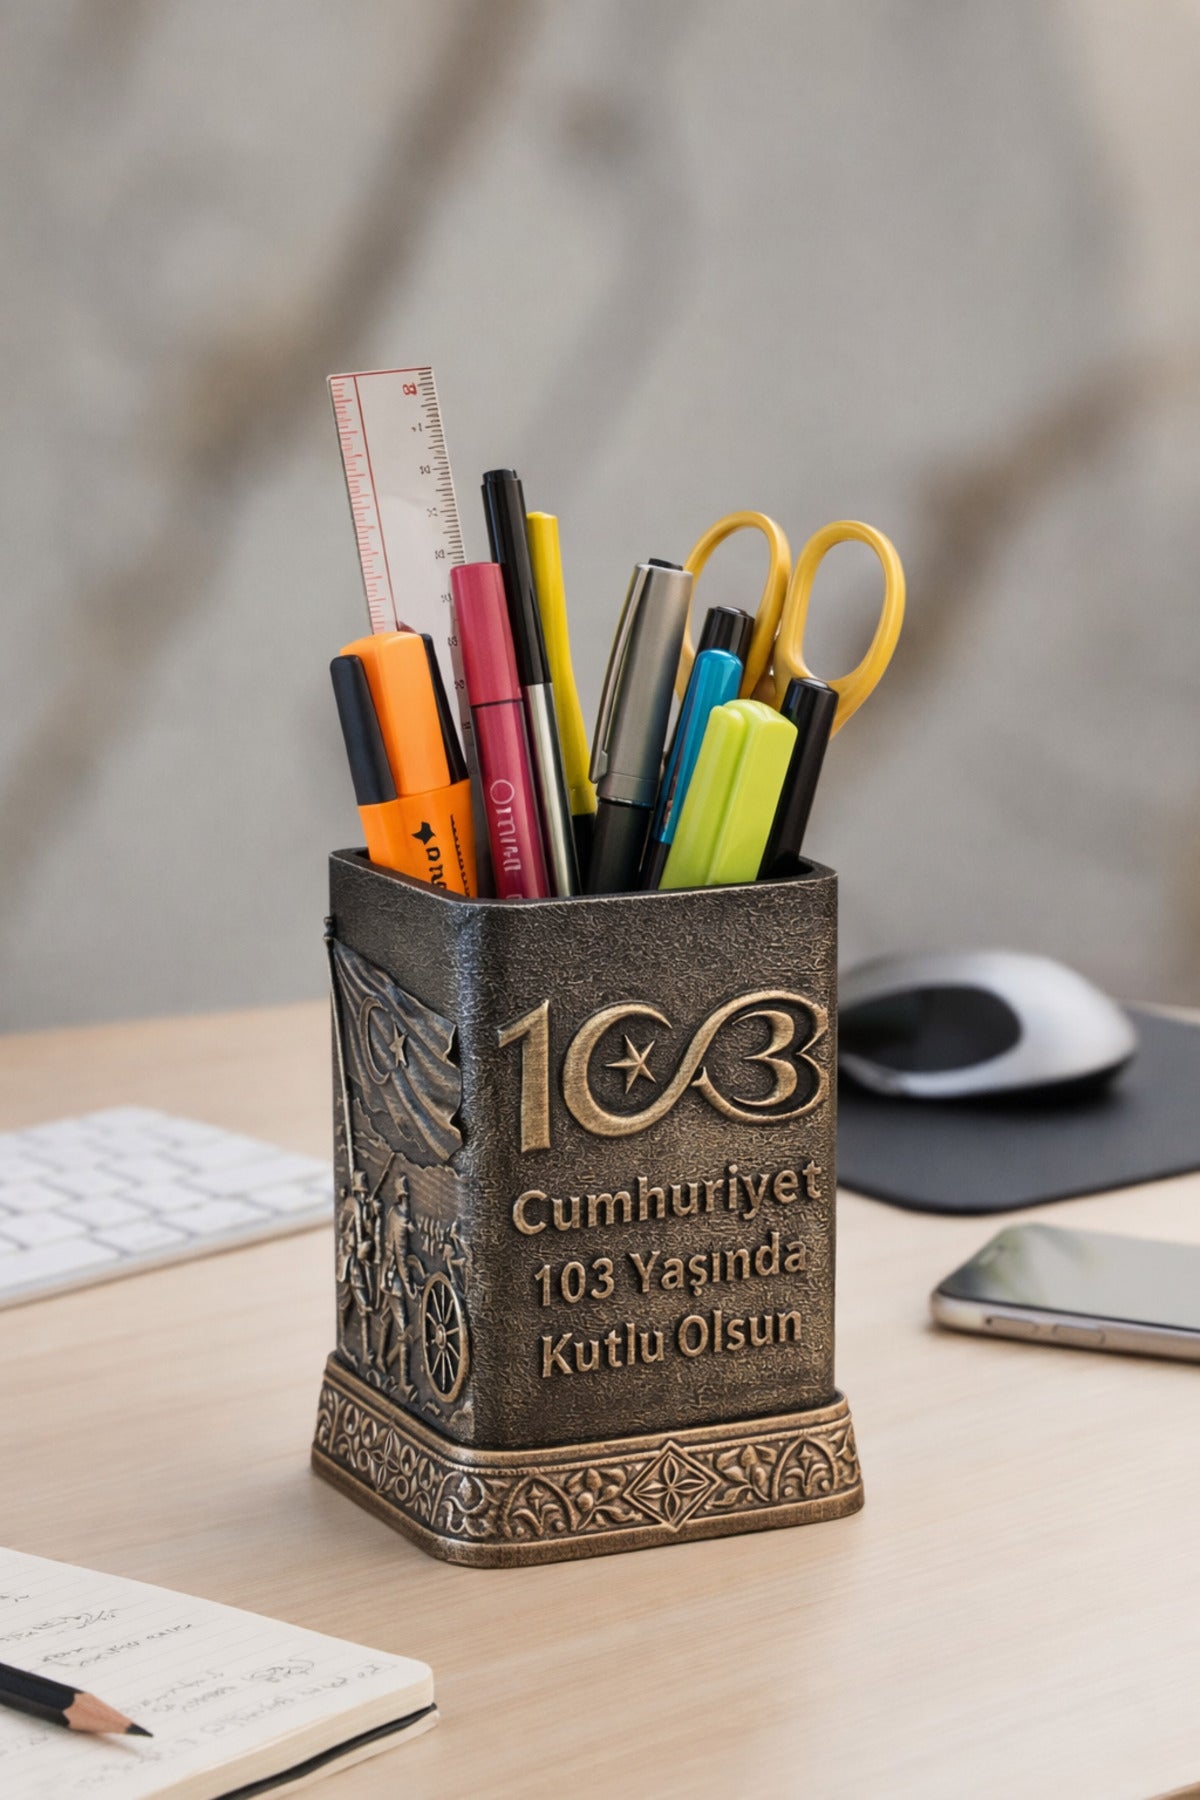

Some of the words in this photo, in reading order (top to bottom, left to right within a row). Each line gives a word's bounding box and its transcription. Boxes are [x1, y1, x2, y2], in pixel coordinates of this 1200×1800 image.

[511, 1159, 824, 1236] Cumhuriyet
[534, 1256, 616, 1308] 103
[629, 1231, 808, 1297] Yaşında
[541, 1322, 666, 1379] Kutlu
[677, 1308, 803, 1358] Olsun
